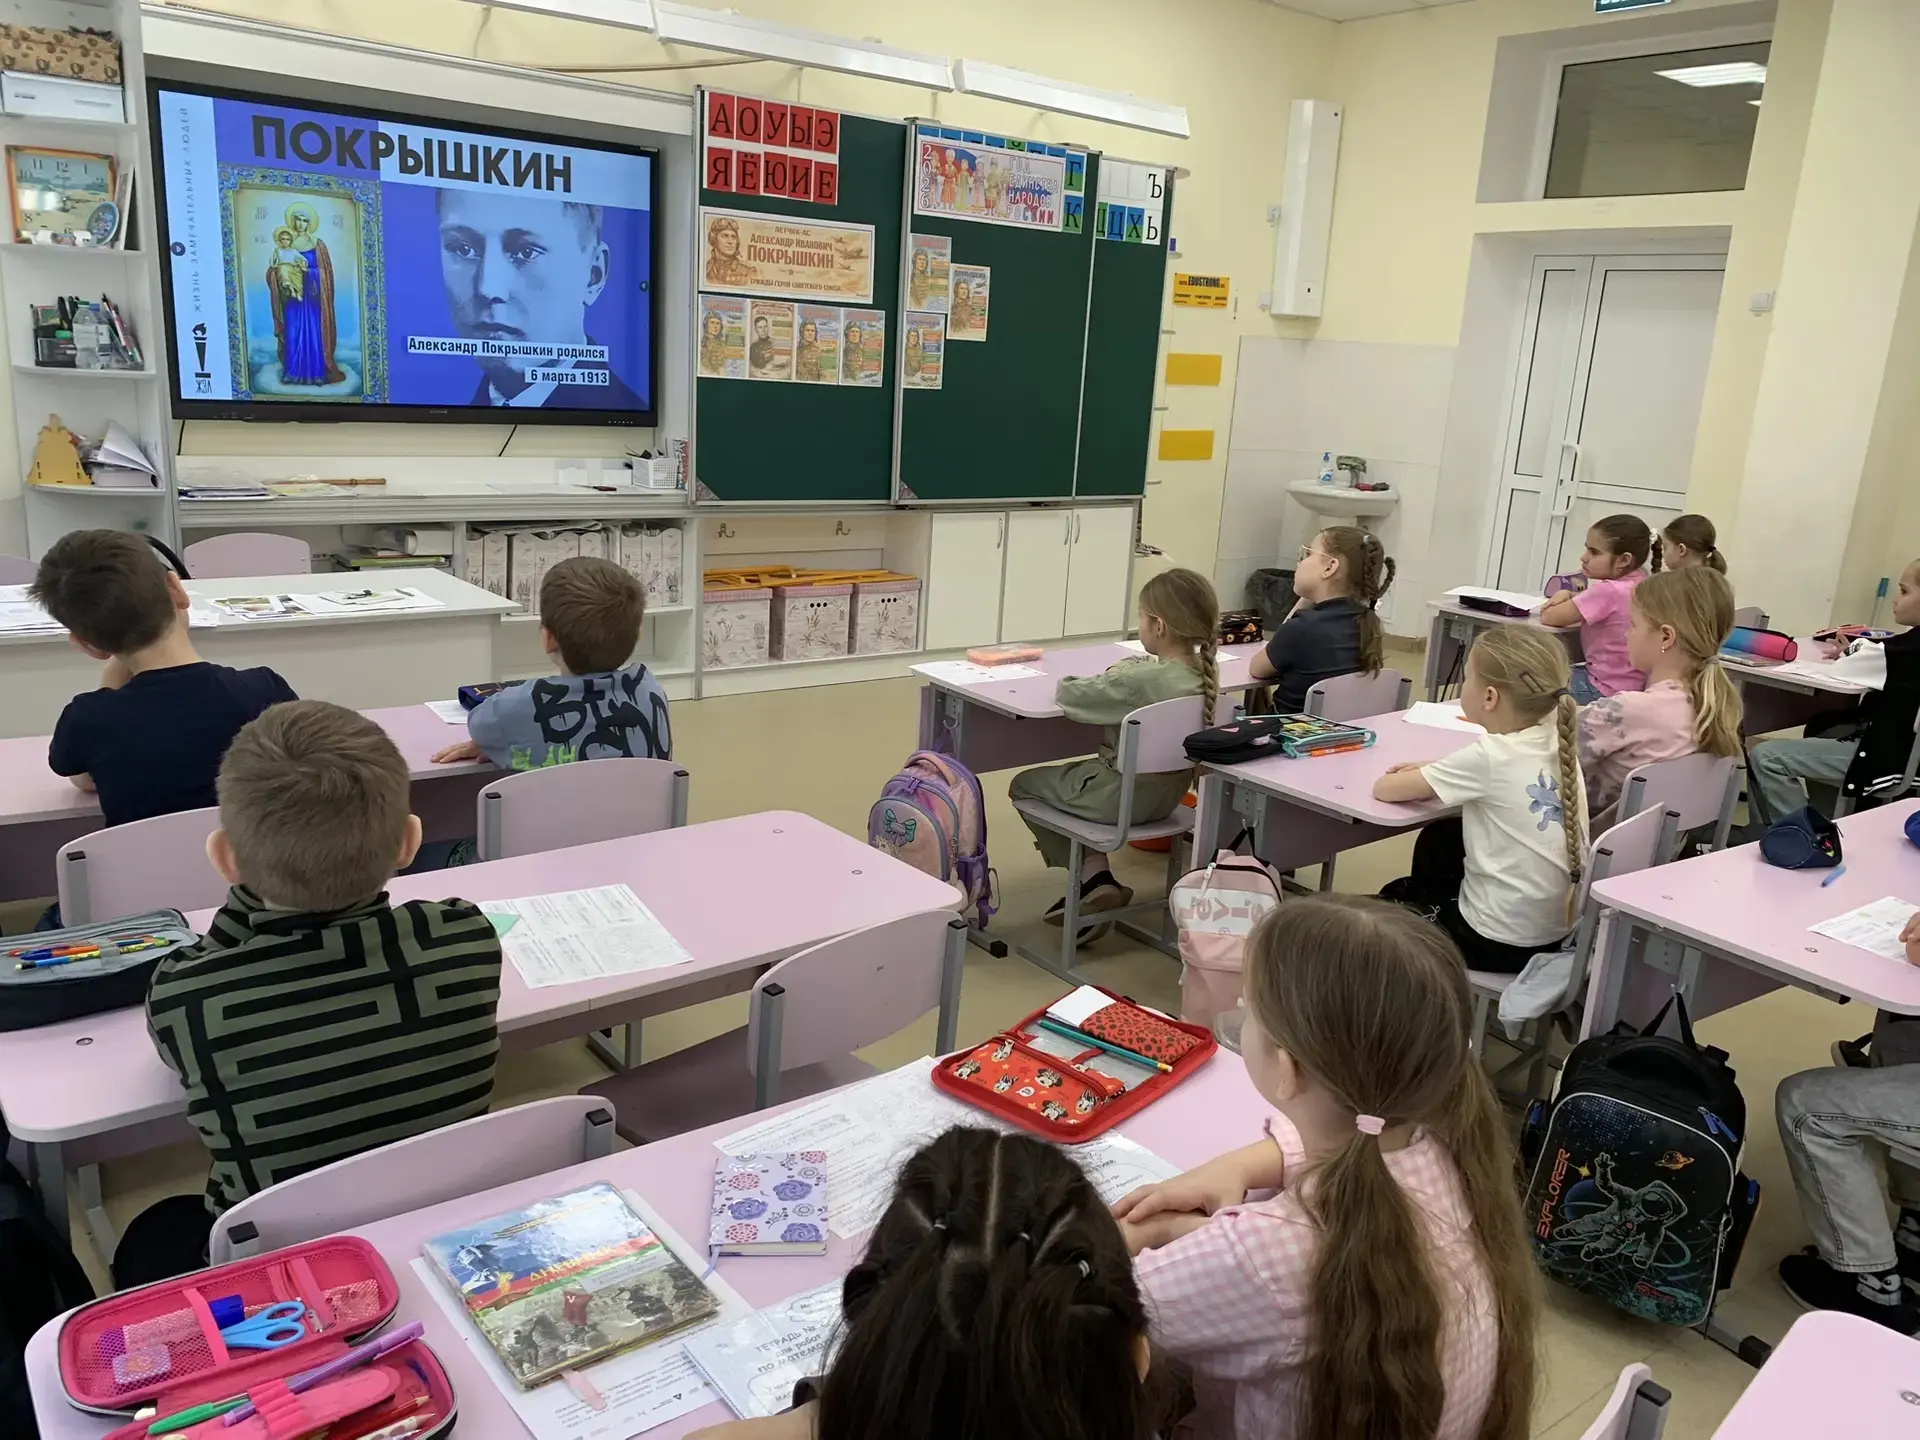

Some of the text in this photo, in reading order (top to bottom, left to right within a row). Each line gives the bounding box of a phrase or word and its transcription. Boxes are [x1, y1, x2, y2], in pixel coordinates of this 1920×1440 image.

[252, 114, 572, 193] ПОКРЫШКИН
[184, 159, 199, 264] ЗАМЕЧАТЕЛЬНЫХ
[193, 270, 202, 313] ЖИЗНЬ
[409, 337, 605, 359] Александр Покрышкин родился
[531, 369, 608, 385] 6 марта 1913
[1536, 1148, 1571, 1238] EXPLORER
[795, 1334, 821, 1350] работ
[757, 1362, 775, 1373] по
